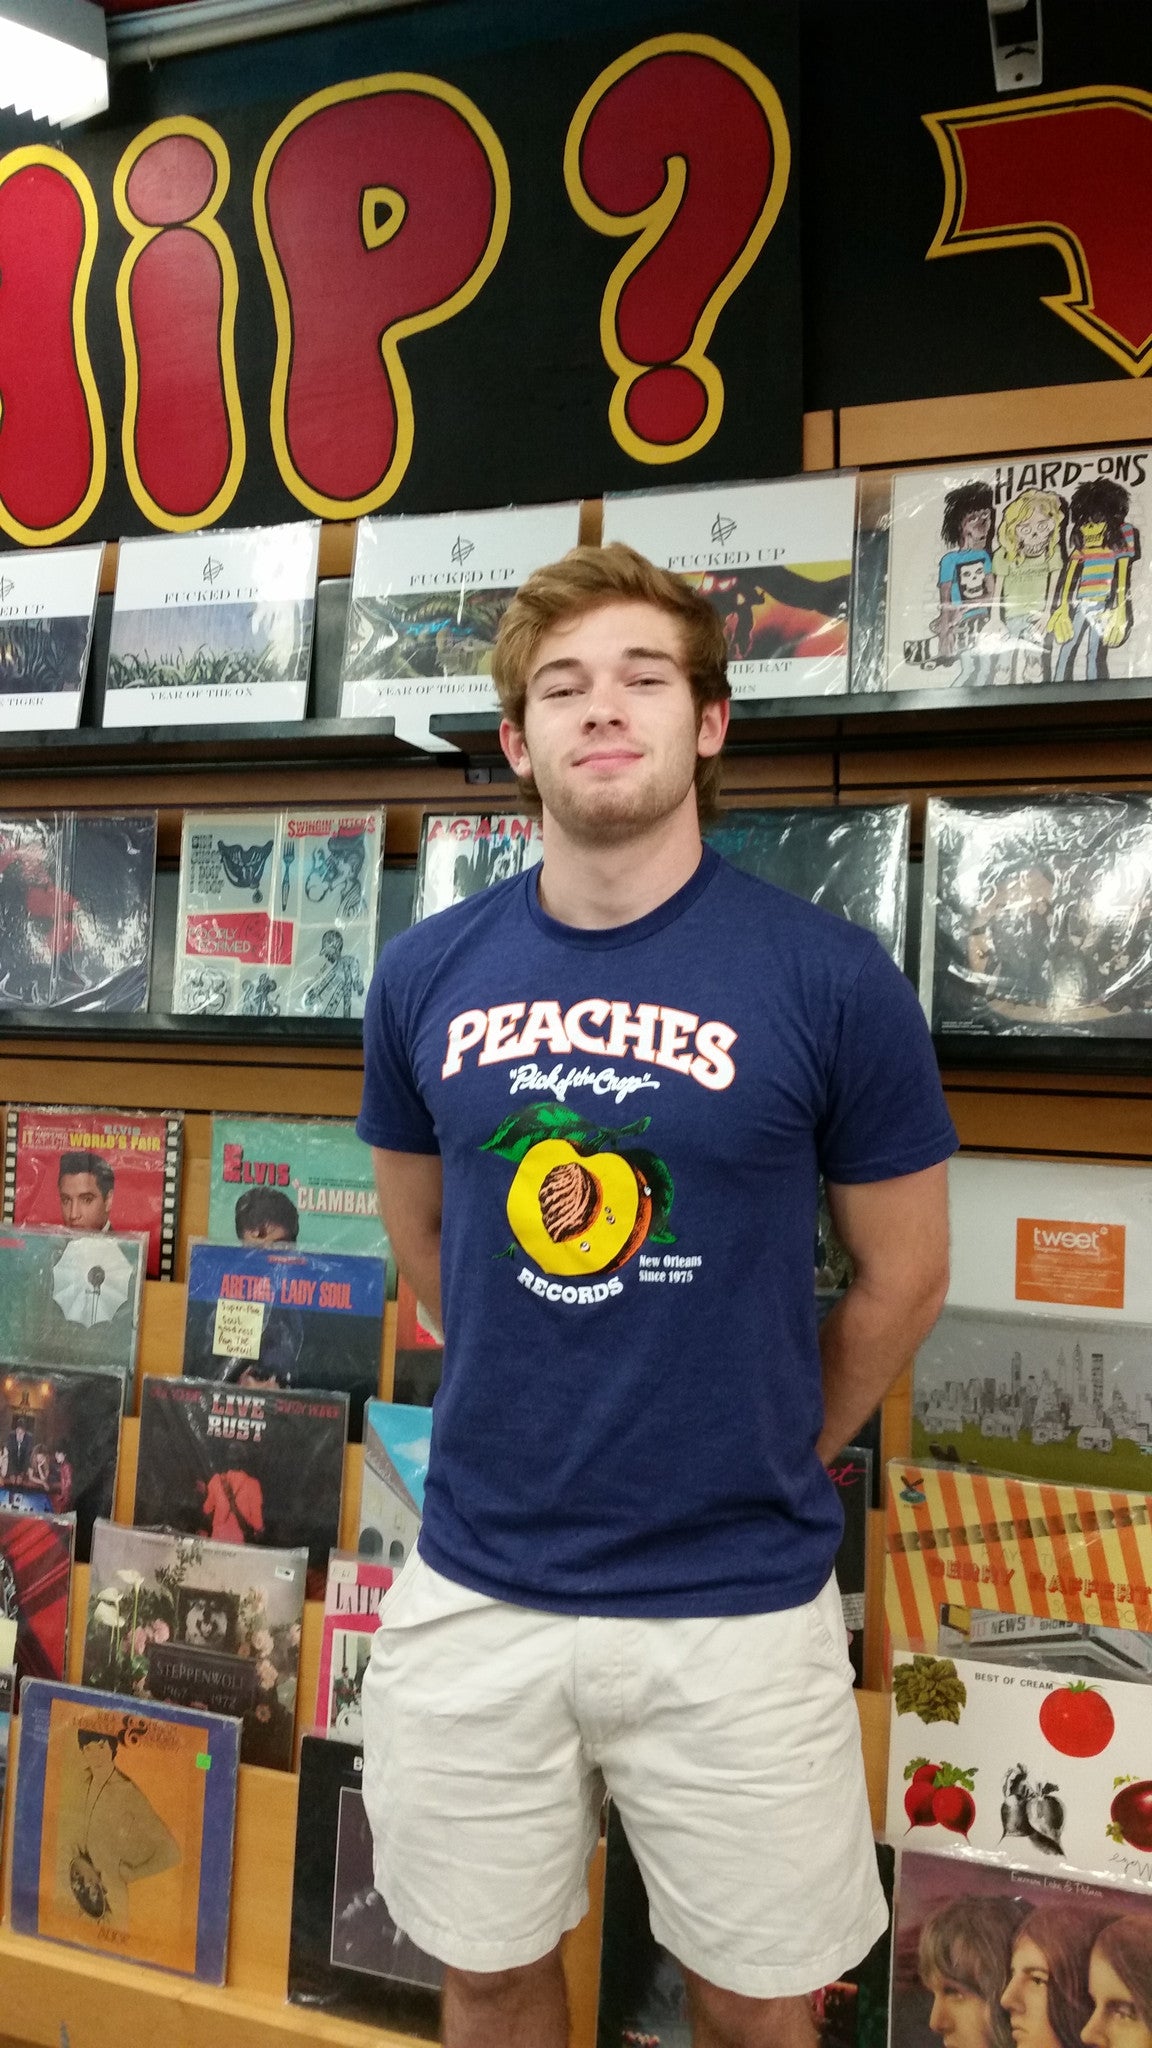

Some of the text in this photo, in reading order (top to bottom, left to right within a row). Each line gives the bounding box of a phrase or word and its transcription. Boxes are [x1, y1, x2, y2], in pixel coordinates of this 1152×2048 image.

[994, 453, 1148, 505] HARD-ONS
[667, 548, 786, 568] FUCKED UP
[409, 568, 515, 586] FUCKED UP
[164, 587, 260, 604] FUCKED UP
[759, 661, 793, 673] RAT
[151, 687, 253, 700] YEAR OF THE OX
[378, 685, 411, 697] YEAR
[415, 685, 433, 695] OF
[436, 684, 465, 694] THE
[442, 998, 738, 1091] PEACHES
[69, 1132, 127, 1150] WORLD'S
[131, 1135, 161, 1151] FAIR
[223, 1143, 291, 1187] ELVIS
[1033, 1226, 1100, 1249] tweet
[639, 1253, 702, 1268] New Orleans
[516, 1267, 624, 1304] RECORDS
[639, 1269, 693, 1283] Since 1975
[280, 1277, 317, 1306] LADY
[318, 1281, 352, 1309] SOUL
[211, 1393, 266, 1420] LIVE
[206, 1414, 267, 1442] RUST
[990, 1616, 1026, 1635] NEWS
[156, 1660, 246, 1689] STEPPENWOLF
[974, 1672, 1055, 1691] BEST OF CREAM
